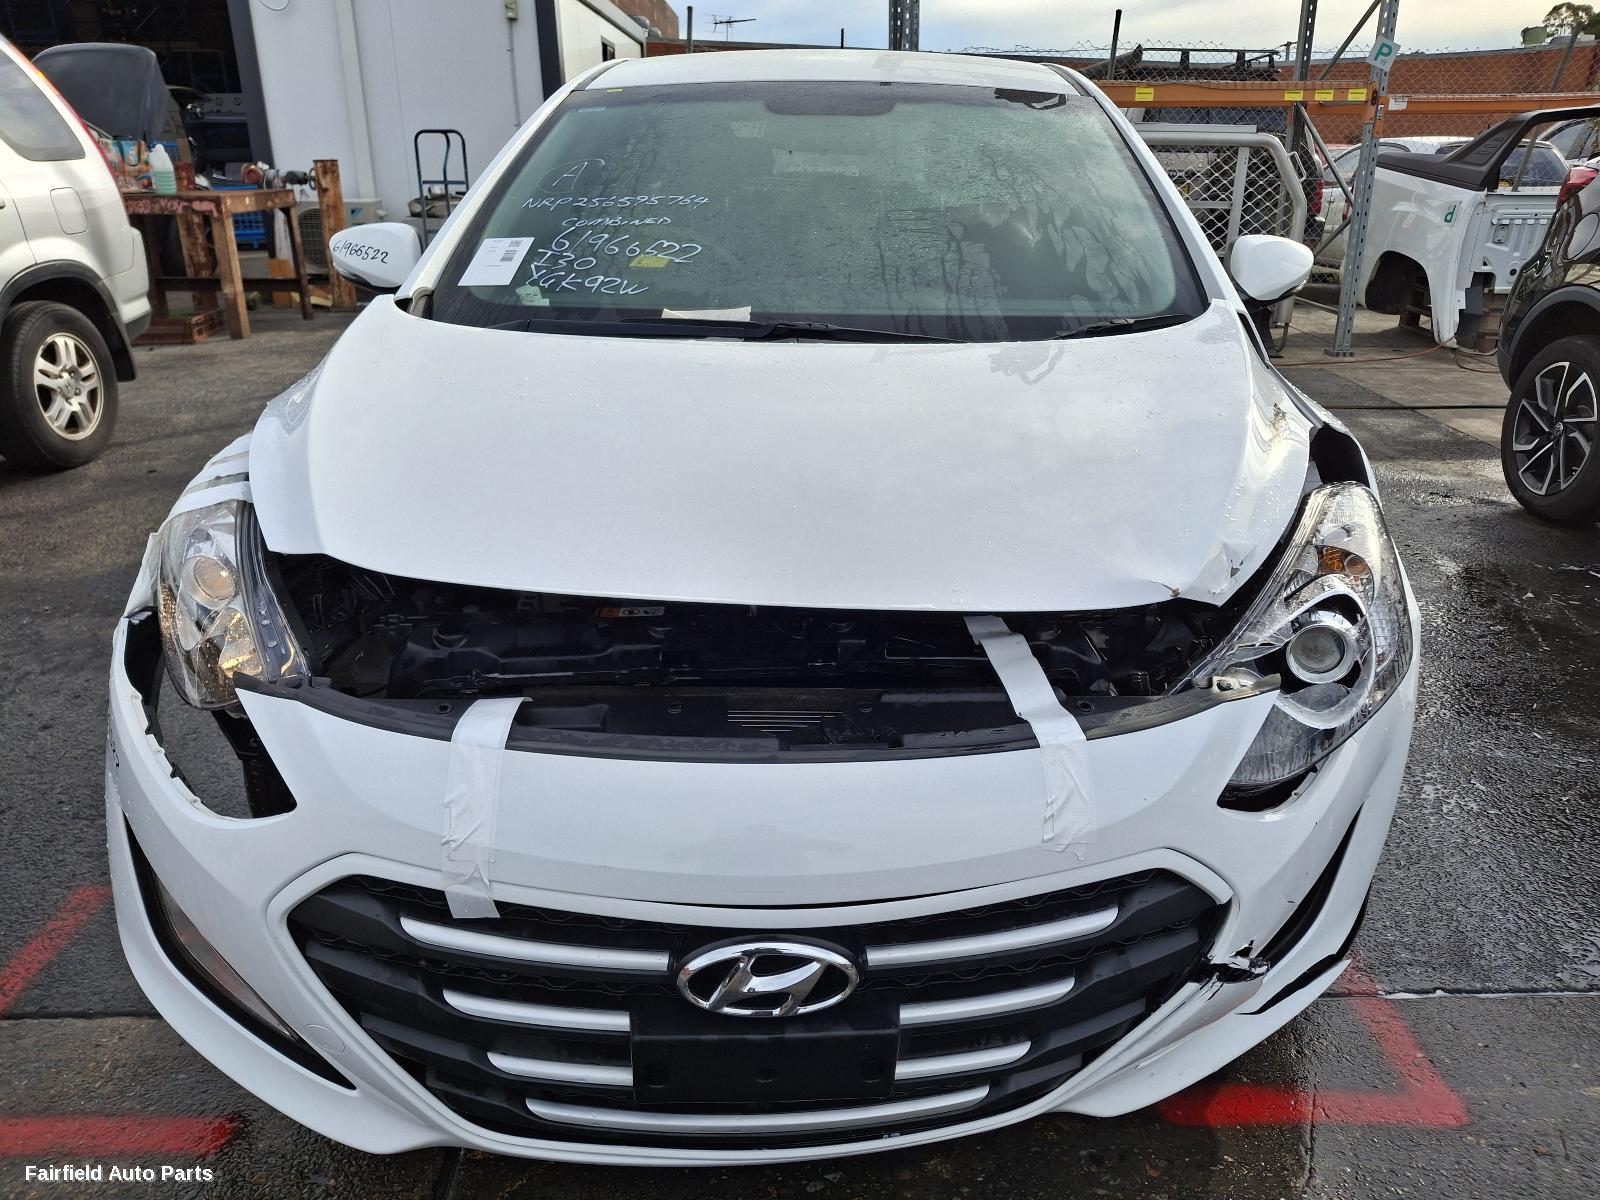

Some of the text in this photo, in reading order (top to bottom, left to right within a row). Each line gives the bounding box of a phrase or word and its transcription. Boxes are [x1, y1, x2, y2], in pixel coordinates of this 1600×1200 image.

[1374, 42, 1393, 61] P
[551, 161, 588, 191] A
[561, 216, 673, 227] COMBINED
[332, 240, 389, 264] 61966522
[551, 226, 703, 263] 61966522
